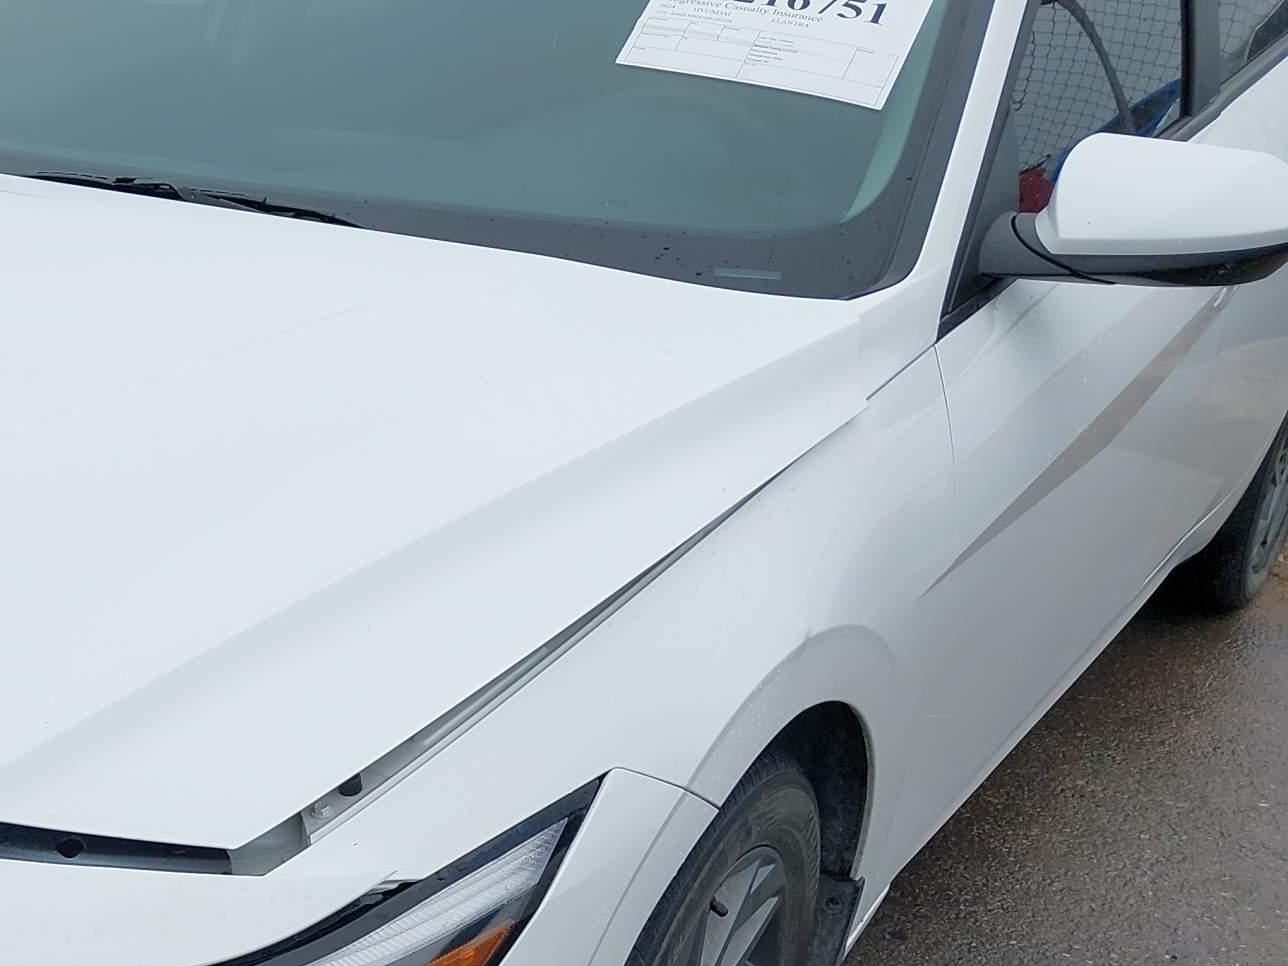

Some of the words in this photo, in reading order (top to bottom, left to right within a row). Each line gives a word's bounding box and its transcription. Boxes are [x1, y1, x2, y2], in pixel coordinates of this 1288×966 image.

[693, 7, 731, 16] HYUNDAI
[771, 18, 810, 28] ELANTRA
[725, 2, 767, 15] Casualty
[773, 8, 824, 22] Insurance
